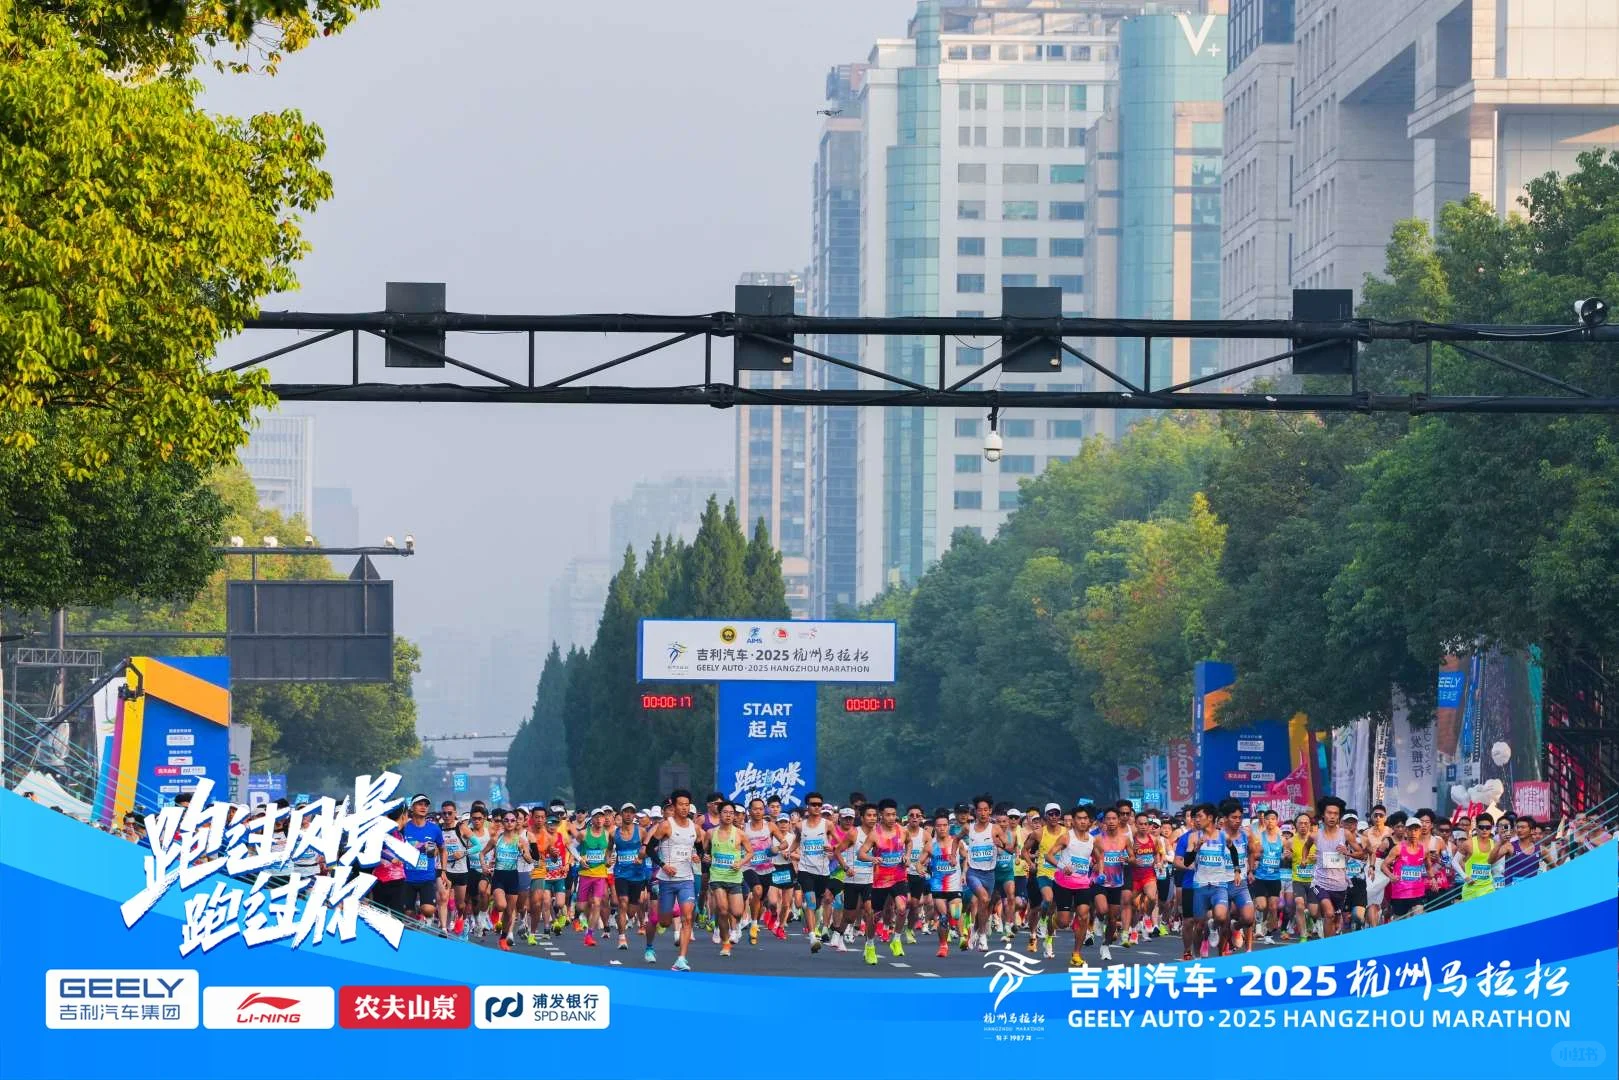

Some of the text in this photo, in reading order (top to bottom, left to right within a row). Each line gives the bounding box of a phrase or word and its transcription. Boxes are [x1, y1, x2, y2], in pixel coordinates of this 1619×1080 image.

[792, 647, 870, 662] 杭州马拉松
[696, 664, 719, 672] GEELY
[770, 665, 820, 673] HANGZHOU
[821, 665, 870, 673] MARATHON
[1438, 676, 1461, 688] EELY
[643, 696, 692, 708] 00:00:17
[846, 698, 894, 711] 00:00:17
[742, 703, 793, 716] START
[747, 720, 788, 738] 起点
